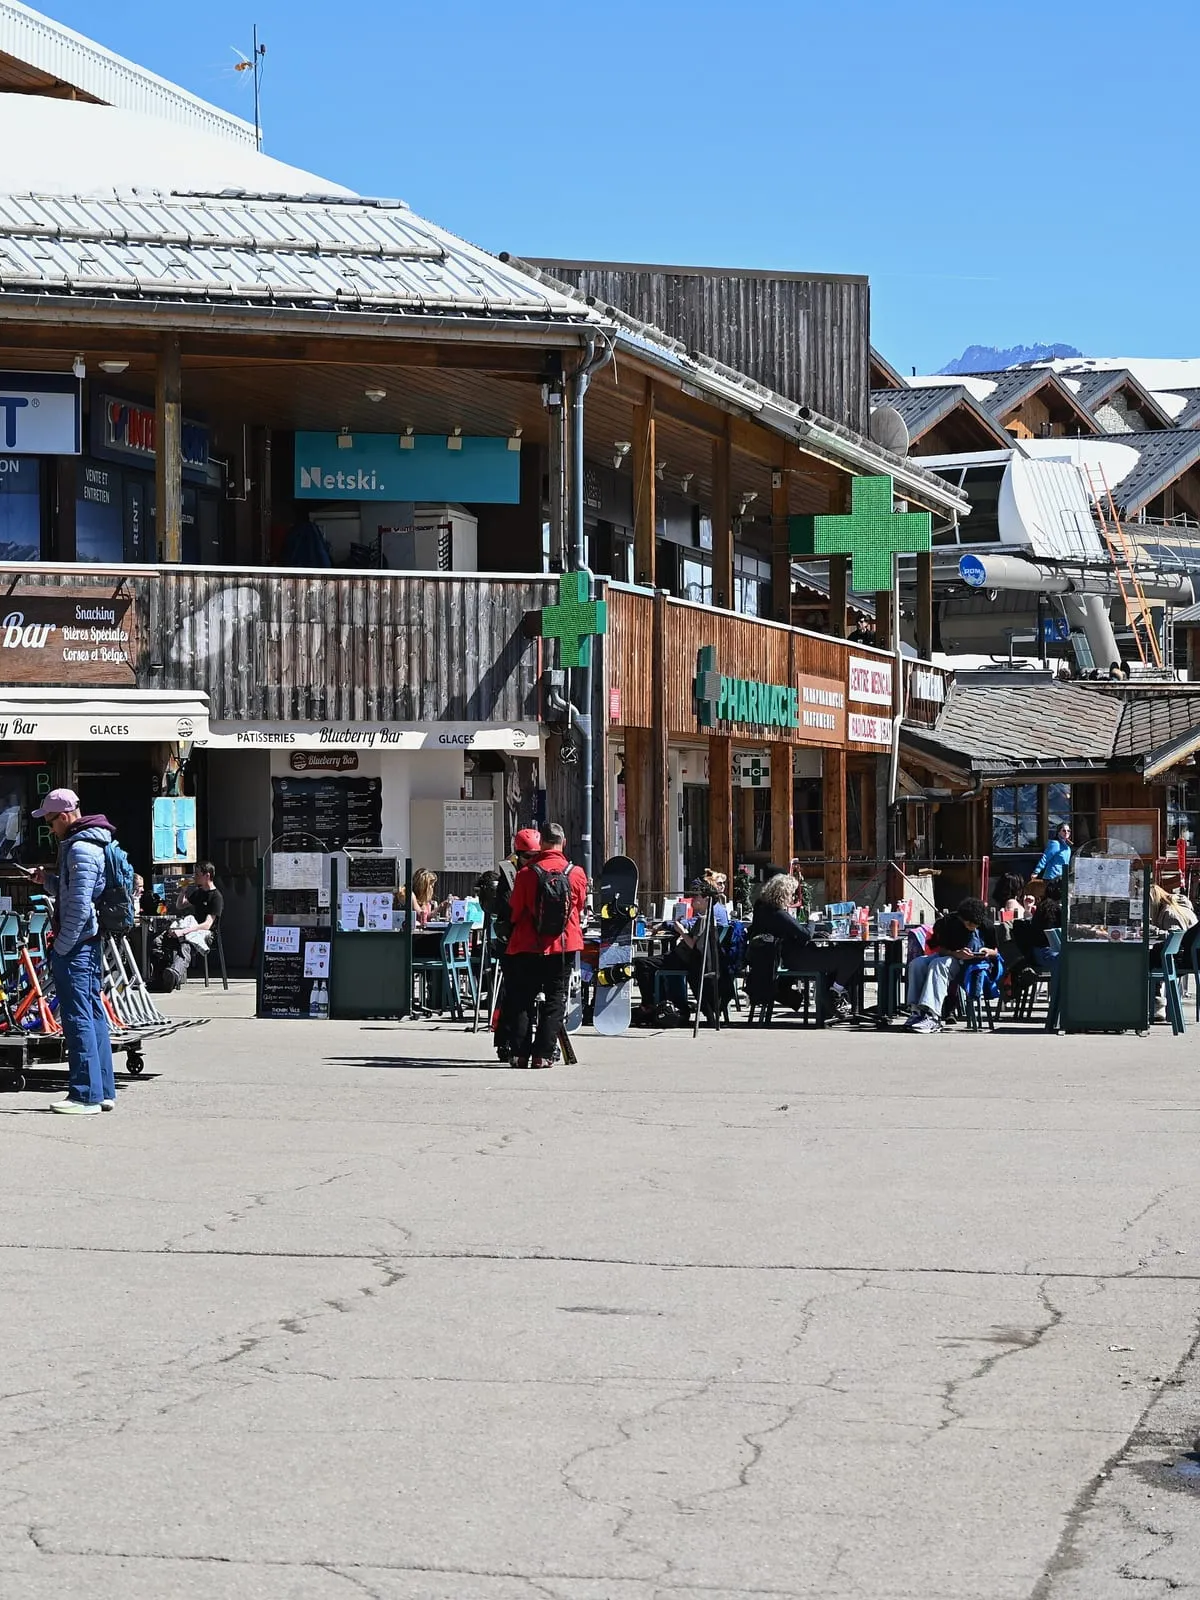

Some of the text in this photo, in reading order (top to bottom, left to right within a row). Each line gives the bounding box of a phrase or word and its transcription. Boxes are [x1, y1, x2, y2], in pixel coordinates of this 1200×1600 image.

[85, 467, 109, 485] VENTE ET
[75, 604, 115, 625] Snacking
[2, 611, 57, 649] Bar
[62, 625, 129, 646] Bières Spéciales
[62, 647, 128, 665] Corses et Belges
[718, 675, 799, 728] PHARMACIE
[12, 717, 38, 735] Bar
[89, 724, 129, 735] GLACES
[237, 732, 296, 743] PATISSERIES
[318, 727, 404, 748] Blueberry Bar
[438, 734, 475, 745] GLACES
[307, 754, 357, 768] Blueberry Bar
[749, 768, 763, 776] ICI
